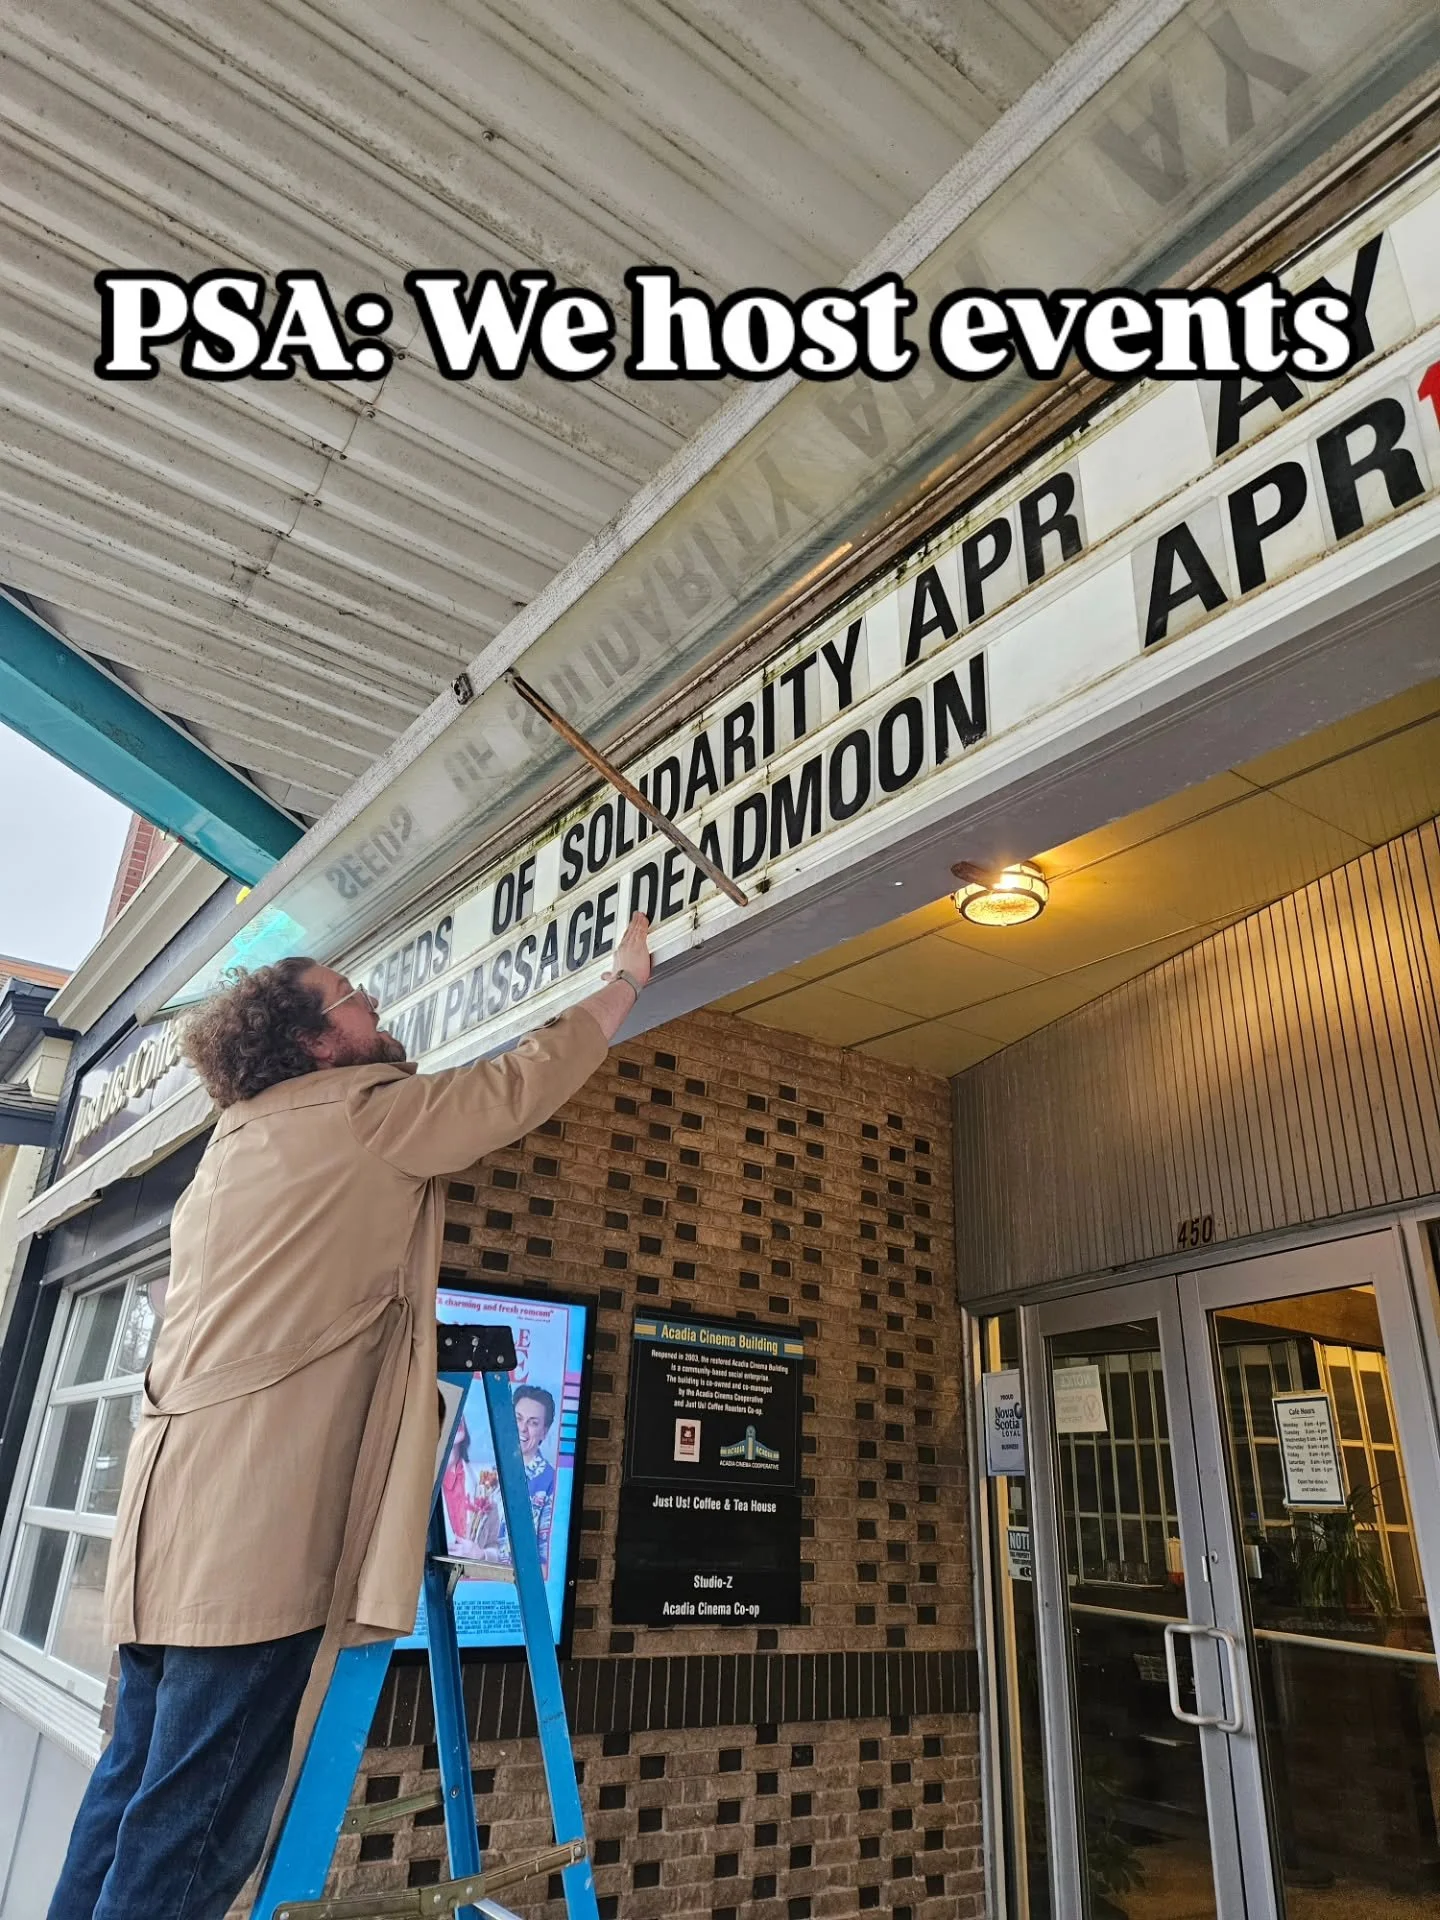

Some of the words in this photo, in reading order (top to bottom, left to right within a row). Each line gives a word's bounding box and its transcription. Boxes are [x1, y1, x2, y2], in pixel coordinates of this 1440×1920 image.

[441, 882, 618, 1042] PASSAGE
[1145, 398, 1425, 648] APR
[368, 915, 452, 1009] SEEDS
[491, 855, 536, 936] OF
[559, 617, 863, 892] SOLIDARITY
[904, 471, 1084, 666] APR
[1177, 1215, 1214, 1249] 450
[445, 1299, 481, 1312] charming
[483, 1303, 497, 1311] and
[499, 1304, 518, 1314] fresh
[661, 1324, 697, 1342] Acadia
[700, 1329, 736, 1347] Cinema
[739, 1334, 778, 1356] Building
[652, 1349, 678, 1361] Reopened
[701, 1354, 709, 1364] the
[710, 1356, 732, 1367] restored
[732, 1359, 749, 1369] Acadia
[750, 1360, 768, 1371] Cinema
[769, 1363, 789, 1375] Building
[682, 1365, 727, 1378] community-based
[728, 1370, 744, 1379] social
[666, 1374, 677, 1383] The
[677, 1375, 699, 1387] building
[706, 1379, 731, 1390] co-owned
[732, 1382, 742, 1390] and
[742, 1383, 773, 1394] co-managed
[678, 1388, 685, 1398] by
[685, 1388, 695, 1397] the
[695, 1389, 714, 1399] Acadia
[714, 1391, 734, 1401] Cinema
[674, 1399, 684, 1407] and
[685, 1400, 697, 1409] Just
[707, 1402, 724, 1412] Coffee
[995, 1407, 1014, 1420] Nova
[995, 1419, 1020, 1431] Scotia
[1002, 1430, 1021, 1438] LOYAL
[653, 1495, 673, 1508] Just
[676, 1496, 690, 1509] Us!
[693, 1496, 721, 1510] Coffee
[724, 1498, 731, 1511] &
[733, 1499, 748, 1512] Tea
[751, 1500, 777, 1513] House
[694, 1575, 733, 1589] Studio-Z
[663, 1601, 695, 1616] Acadia
[698, 1602, 731, 1616] Cinema
[734, 1602, 760, 1618] Co-op
